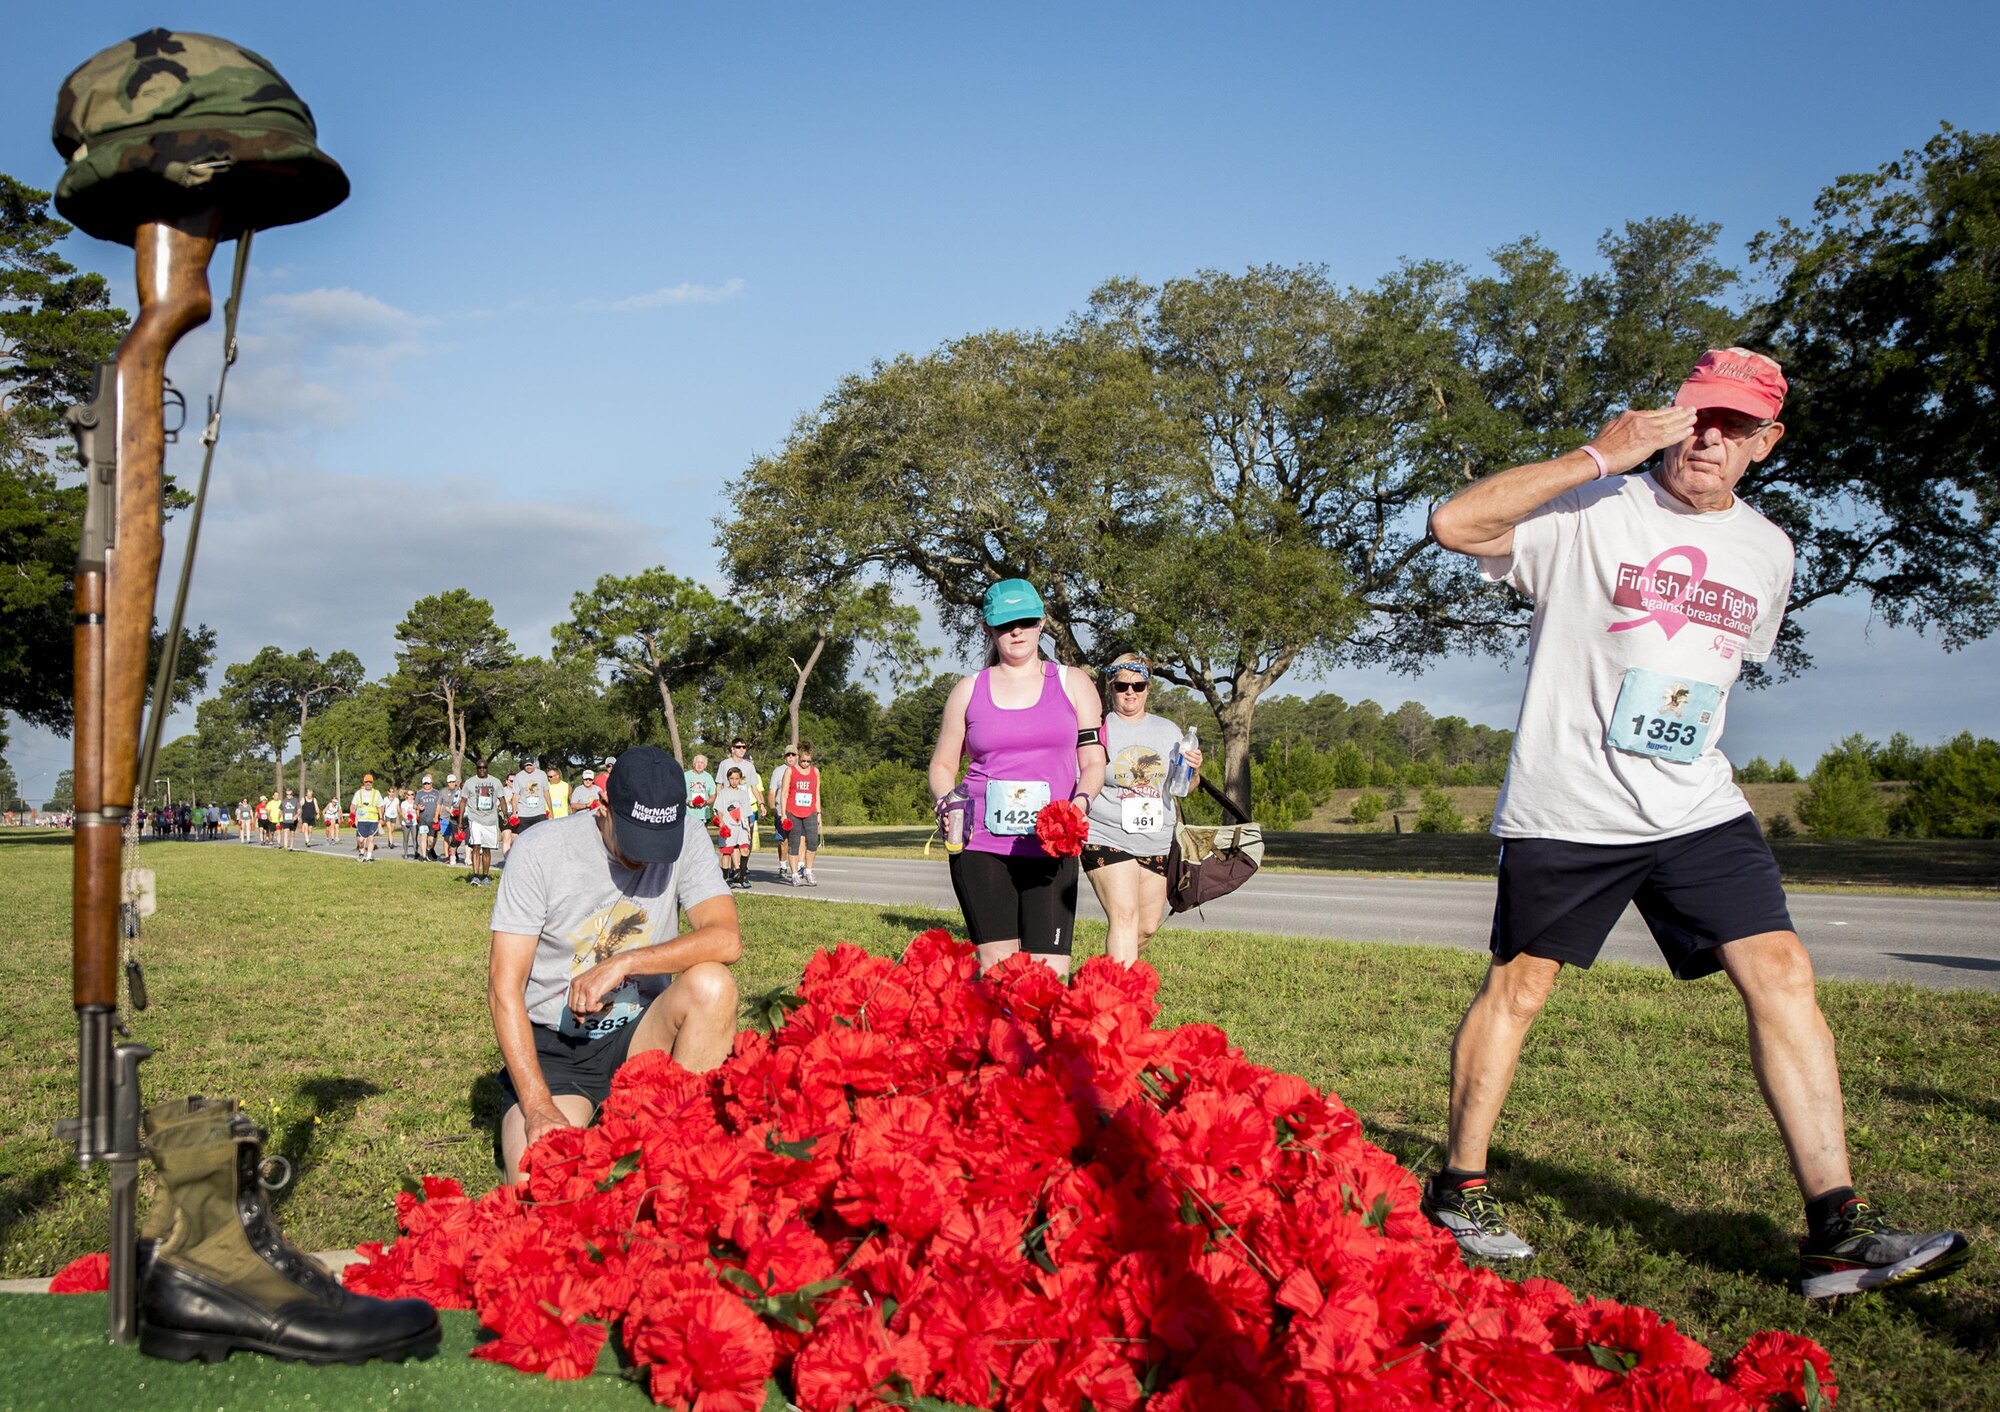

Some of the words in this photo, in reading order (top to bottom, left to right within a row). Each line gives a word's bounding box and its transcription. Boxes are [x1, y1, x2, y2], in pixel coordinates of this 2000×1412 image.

[1618, 567, 1679, 597] Finish
[1685, 581, 1717, 606] the
[1722, 589, 1756, 619] fight
[1640, 597, 1684, 614] against
[1686, 604, 1722, 624] breast
[1632, 714, 1697, 746] 1353
[796, 781, 810, 790] FREE
[631, 808, 678, 824] INSPECTOR
[1132, 816, 1154, 826] 461
[572, 1016, 629, 1031] 1383
